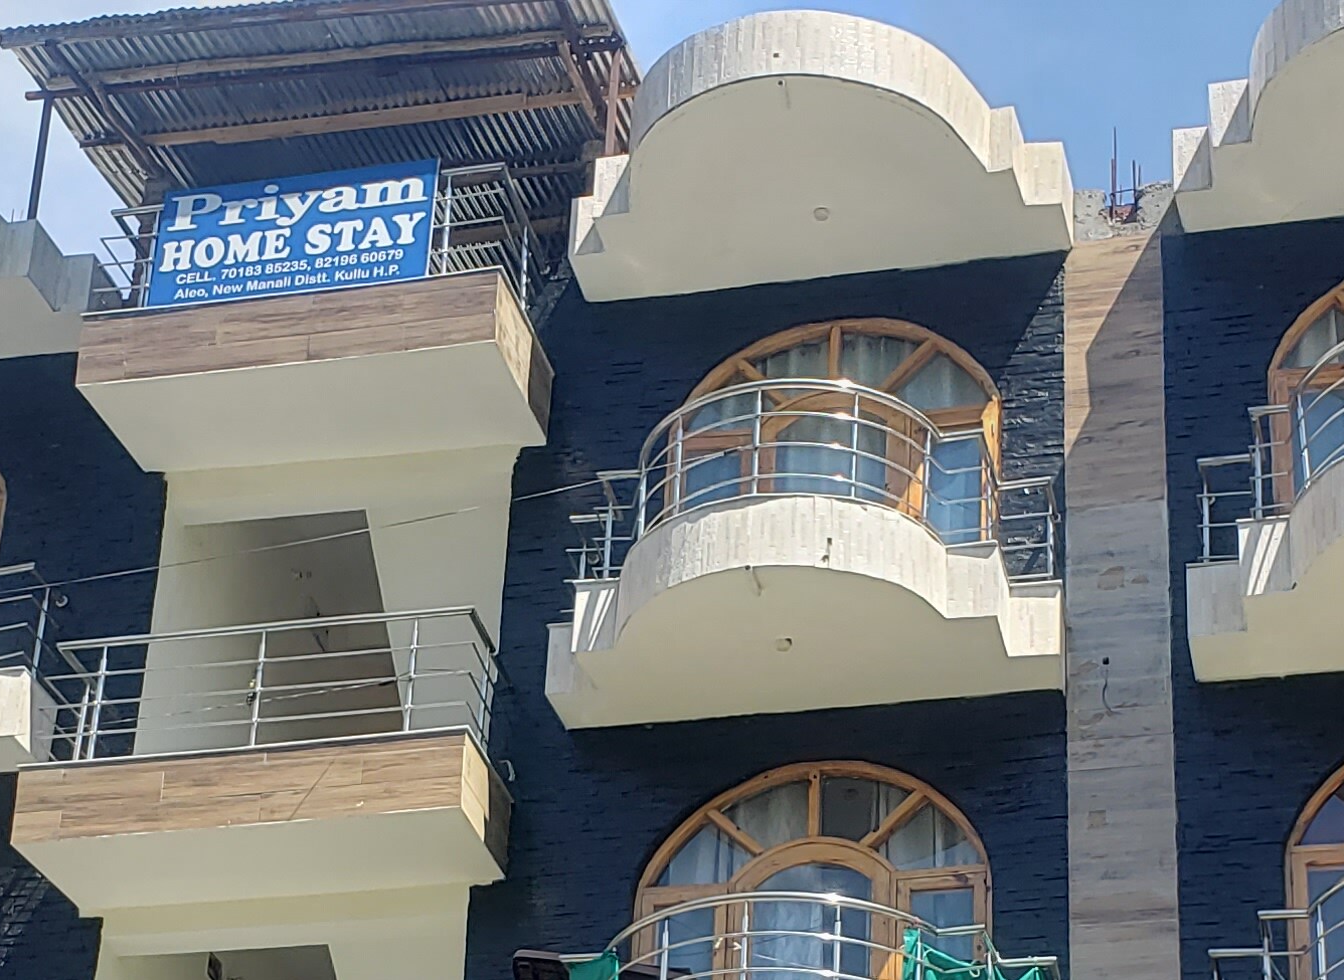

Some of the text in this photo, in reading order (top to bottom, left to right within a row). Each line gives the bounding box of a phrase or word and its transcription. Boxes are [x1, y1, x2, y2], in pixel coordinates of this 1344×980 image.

[167, 177, 428, 232] Priyam
[159, 212, 426, 273] HOME STAY
[174, 264, 400, 300] Aleo, New Manali Distt. Kullu H.P.
[176, 249, 404, 285] CELL. 70183 85235, 82196 60679
